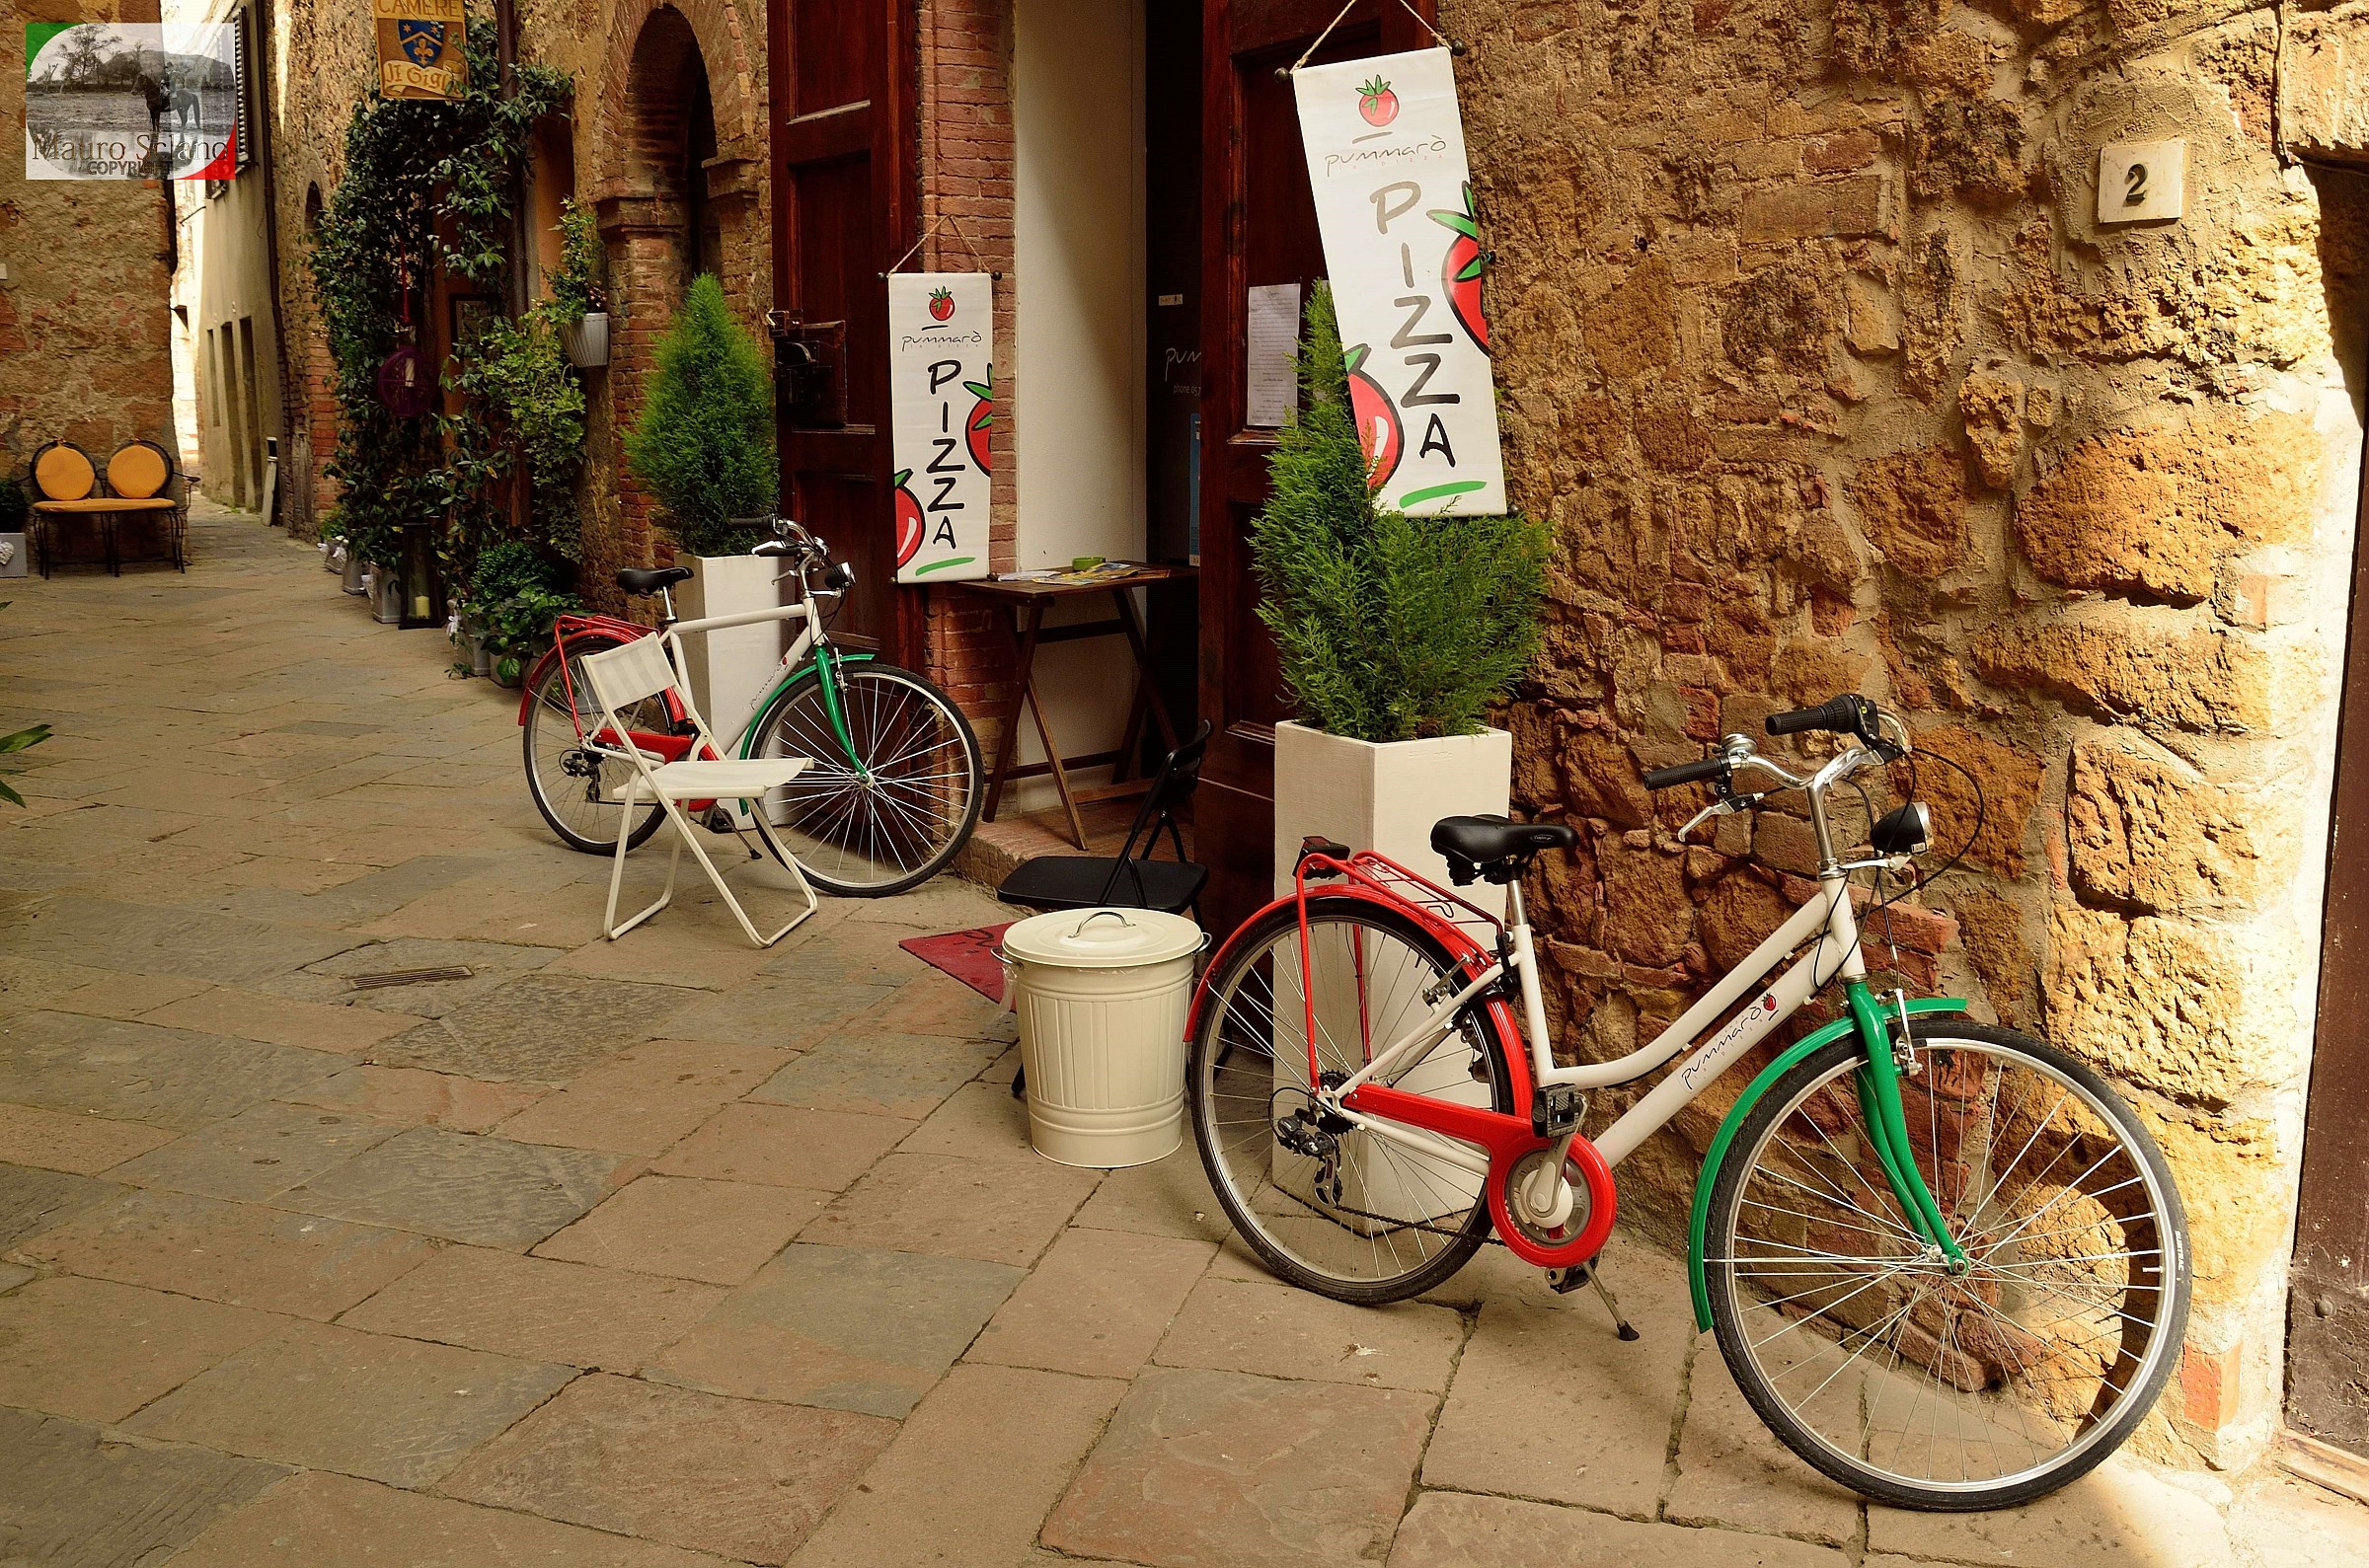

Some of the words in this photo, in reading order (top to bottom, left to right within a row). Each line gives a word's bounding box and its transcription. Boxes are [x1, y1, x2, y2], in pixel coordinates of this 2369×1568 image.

[377, 0, 461, 18] CAMERE
[1325, 134, 1447, 178] pummarò
[2125, 163, 2148, 202] 2
[901, 330, 982, 352] pummarò
[1368, 182, 1461, 468] PIZZA
[1173, 383, 1190, 396] phone
[926, 359, 966, 550] PIZZA
[1681, 1007, 1762, 1089] pummarò
[2175, 1230, 2183, 1271] SUNTRAC
